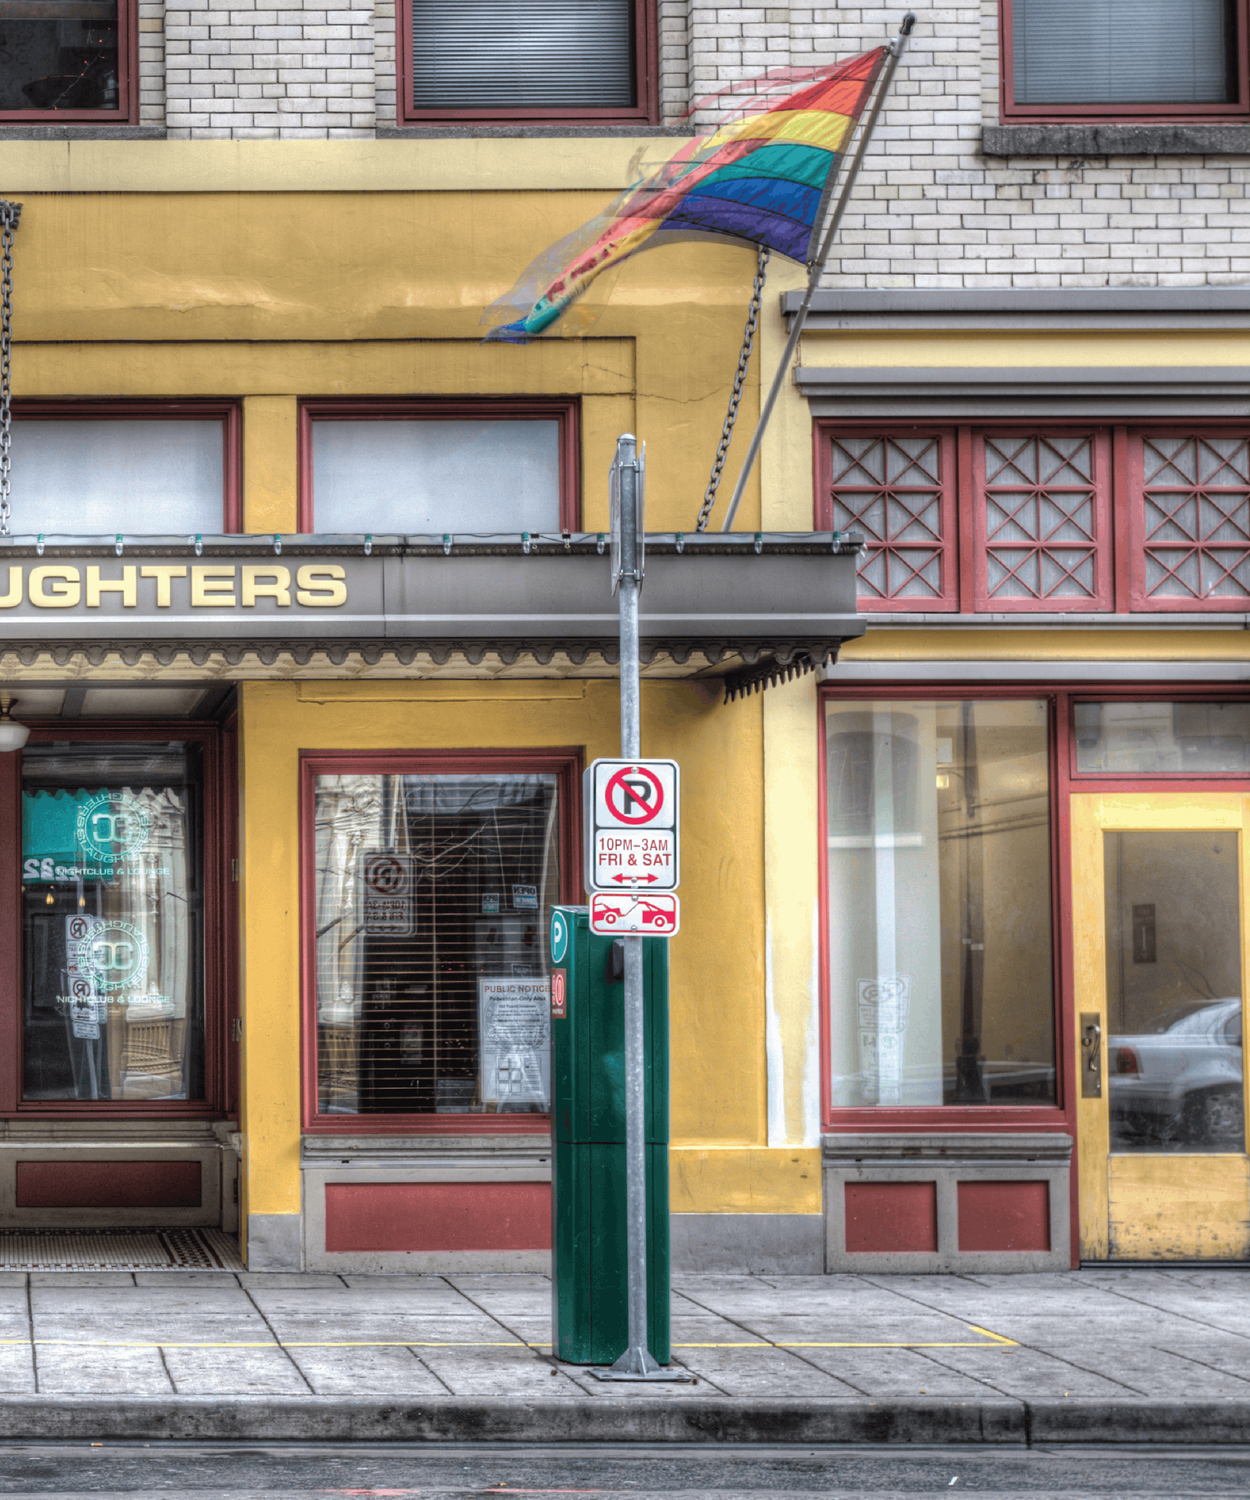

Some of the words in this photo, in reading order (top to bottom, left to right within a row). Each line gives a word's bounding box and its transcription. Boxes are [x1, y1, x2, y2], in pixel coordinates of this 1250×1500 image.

[599, 837, 669, 852] 10PM-3AM
[599, 853, 622, 866] FRI
[627, 853, 638, 866] &
[642, 853, 672, 866] SAT
[56, 868, 114, 876] NIGHTCLUB
[116, 868, 124, 876] &
[127, 868, 170, 876] LOUNGE
[554, 921, 562, 955] P
[484, 985, 516, 993] PUBLIC
[518, 985, 551, 993] NOTICE
[56, 995, 114, 1004] NIGHTCLUB
[116, 995, 125, 1004] &
[127, 995, 170, 1004] LOUNGE
